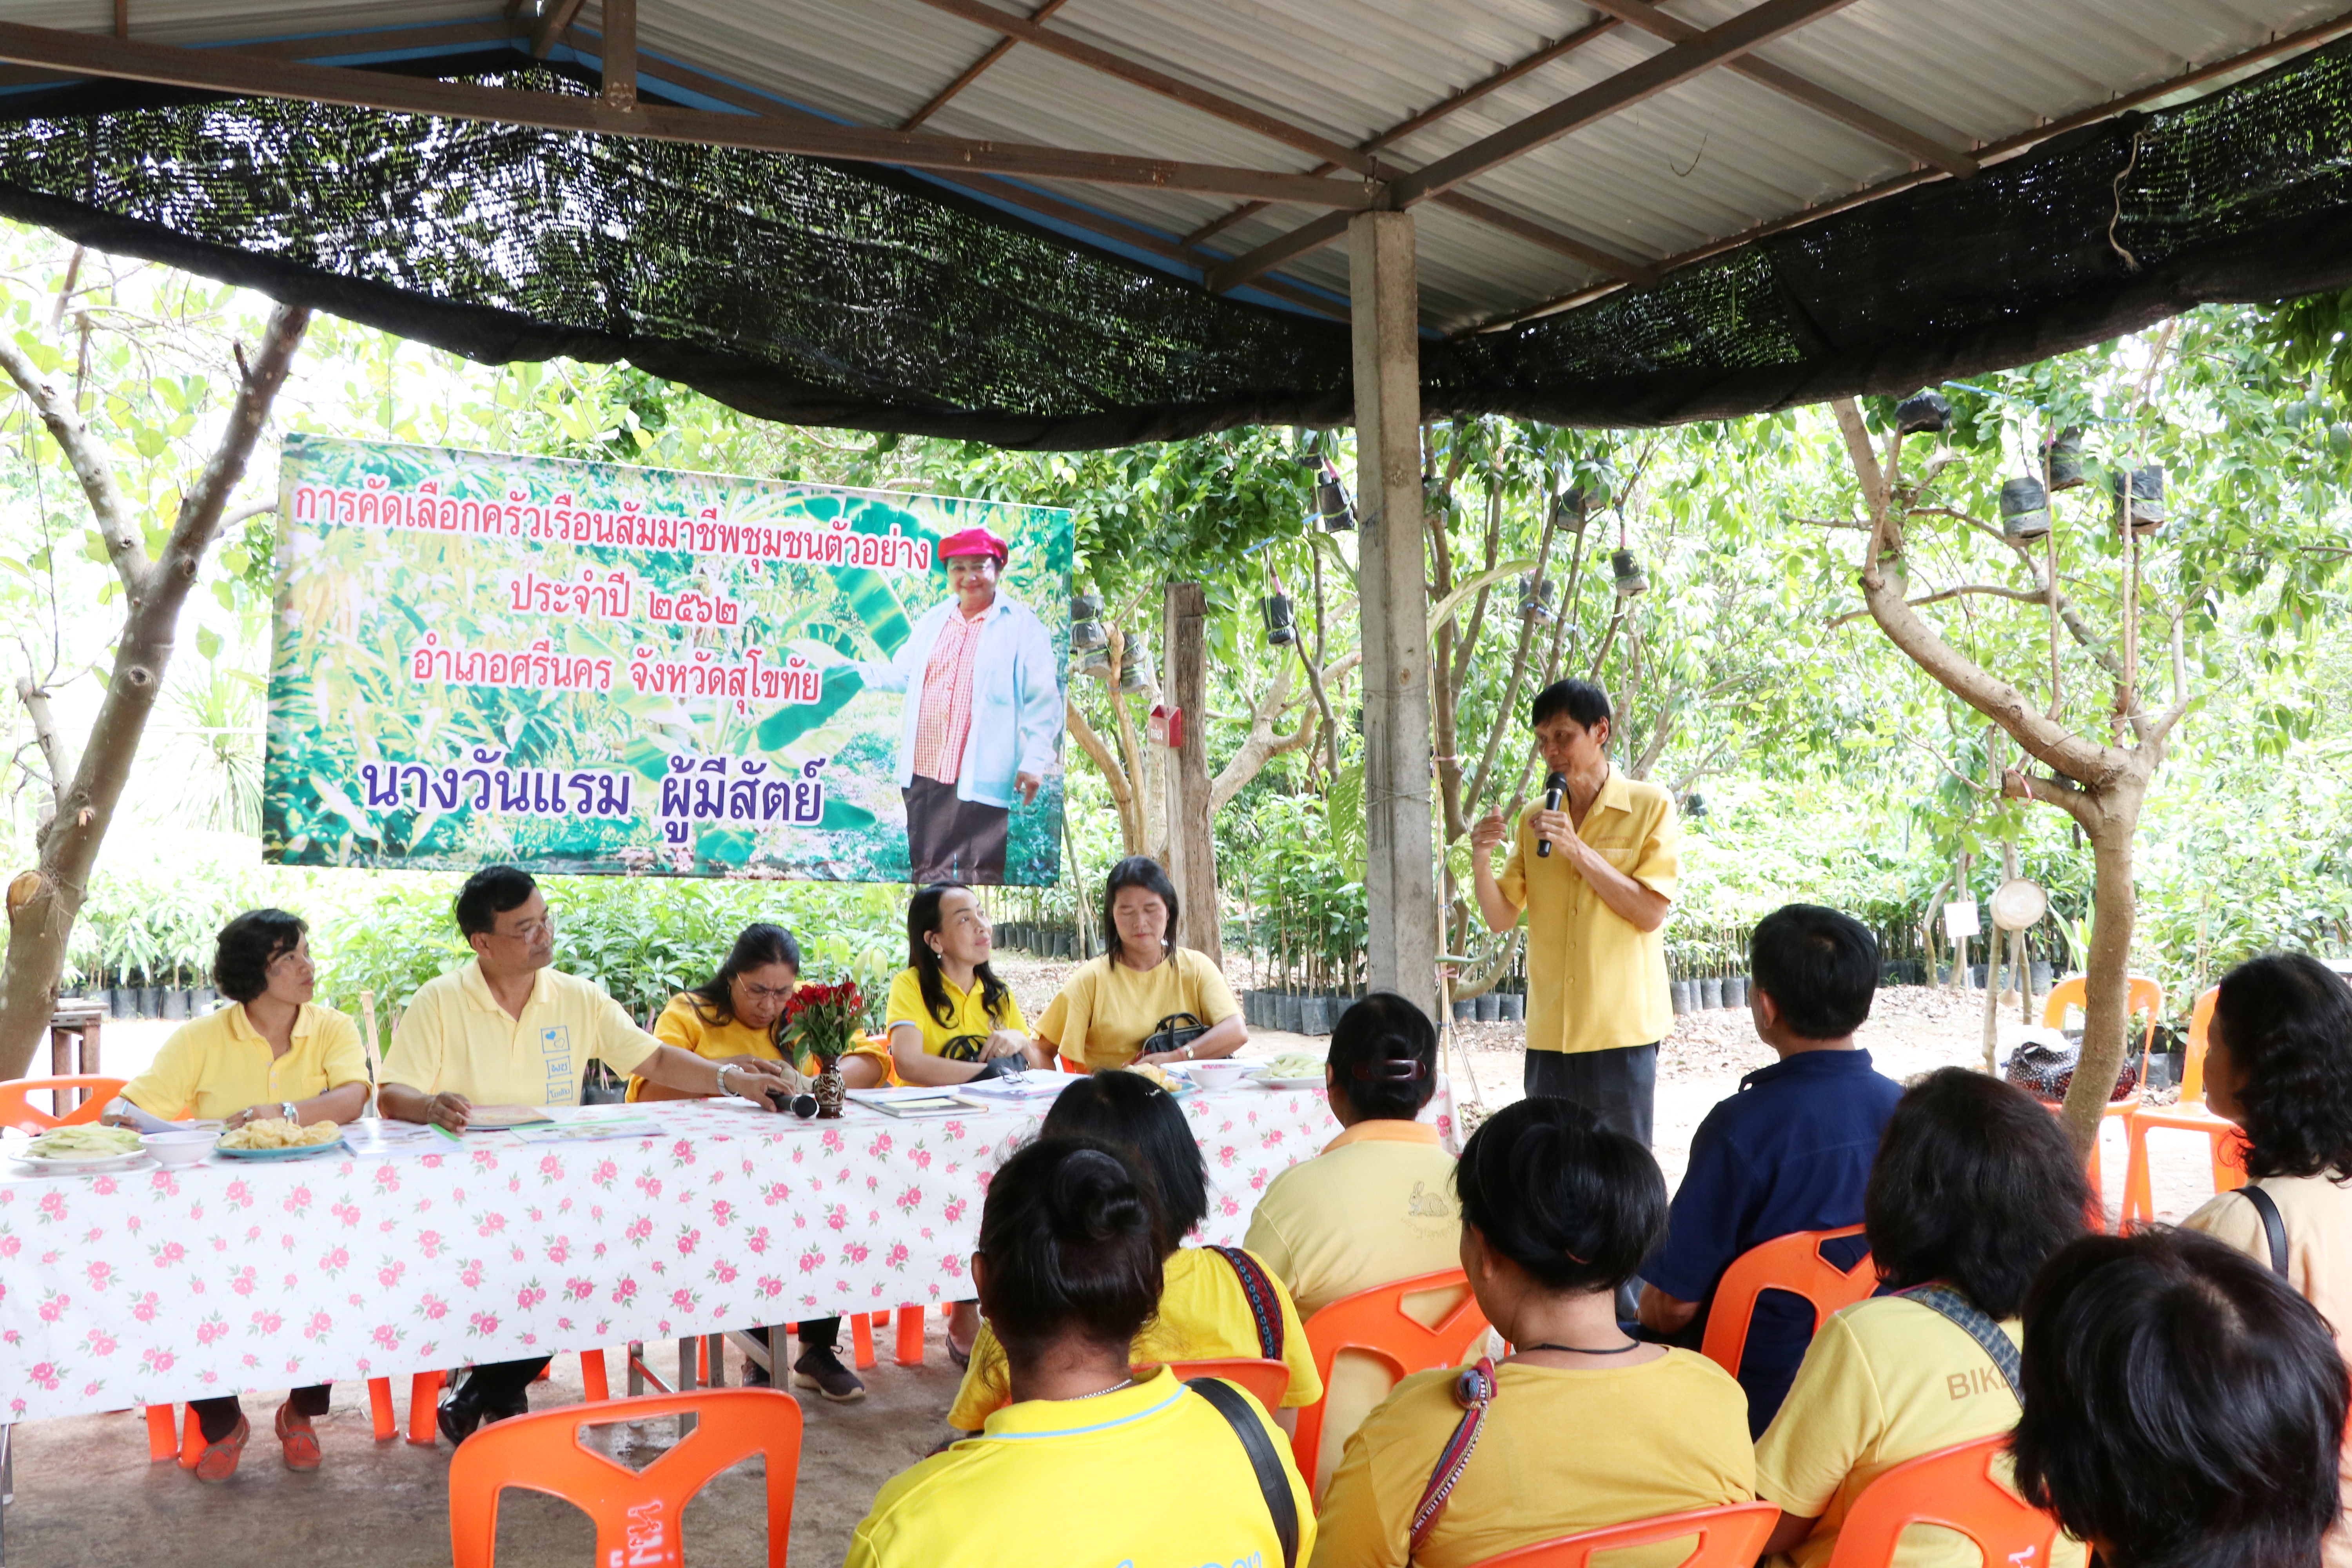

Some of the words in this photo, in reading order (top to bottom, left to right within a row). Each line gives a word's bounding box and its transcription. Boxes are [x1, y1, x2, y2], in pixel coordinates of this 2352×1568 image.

[297, 478, 929, 573] การคัดเลือกครัวเรือนสัมมาชีพชุมชนตัวอย่าง
[511, 569, 630, 617] ประจำปี
[649, 590, 738, 625] ๒๕๖๒
[414, 633, 612, 690] อำเภอศรีนคร
[630, 647, 819, 715] จังหวัดสุโขทัย
[361, 748, 630, 815] นางวันแรม
[661, 755, 826, 844] ผู้มีสัตย์
